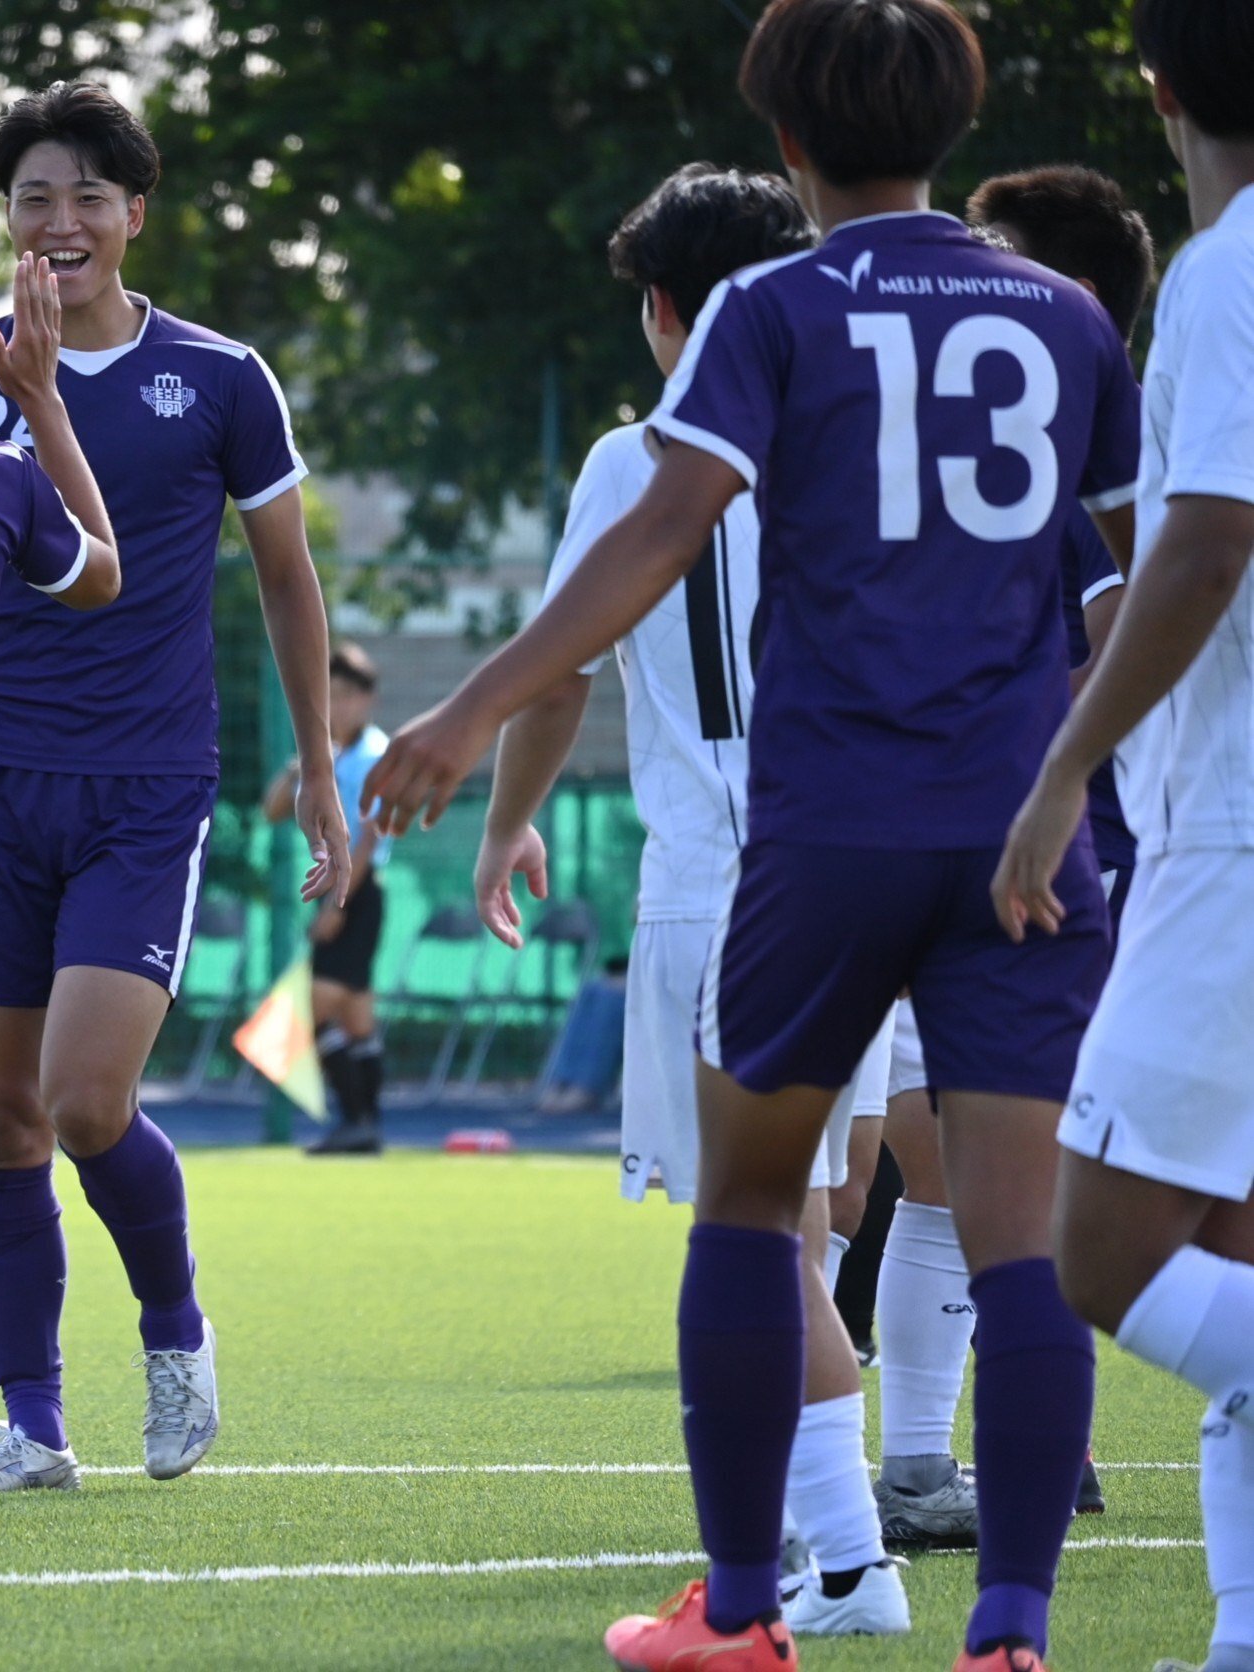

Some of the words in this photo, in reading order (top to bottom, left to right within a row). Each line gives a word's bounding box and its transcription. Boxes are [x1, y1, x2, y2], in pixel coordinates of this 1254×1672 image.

[877, 275, 934, 295] MEIJI
[937, 276, 1054, 303] UNIVERSITY
[847, 313, 1059, 541] 13
